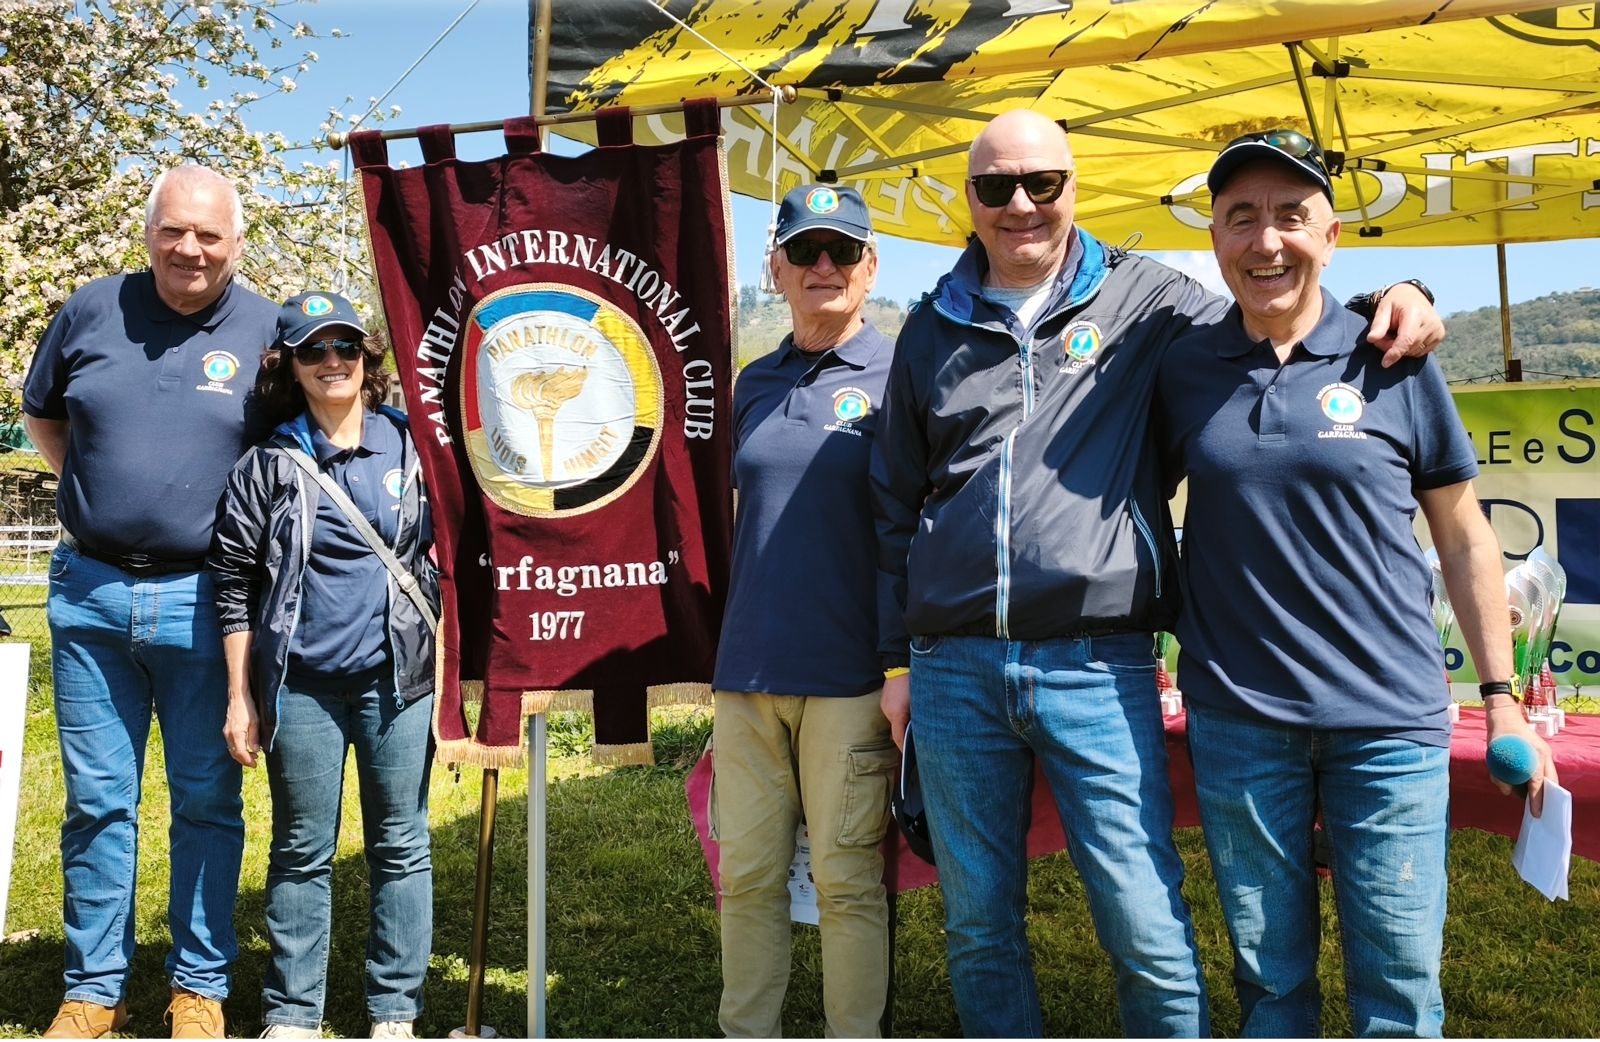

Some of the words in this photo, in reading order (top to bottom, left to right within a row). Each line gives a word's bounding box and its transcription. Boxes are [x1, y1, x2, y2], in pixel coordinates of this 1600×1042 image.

[464, 229, 701, 353] INTERNATIONAL
[682, 359, 715, 441] CLUB
[487, 324, 598, 361] PANATHLON
[528, 611, 585, 641] 1977
